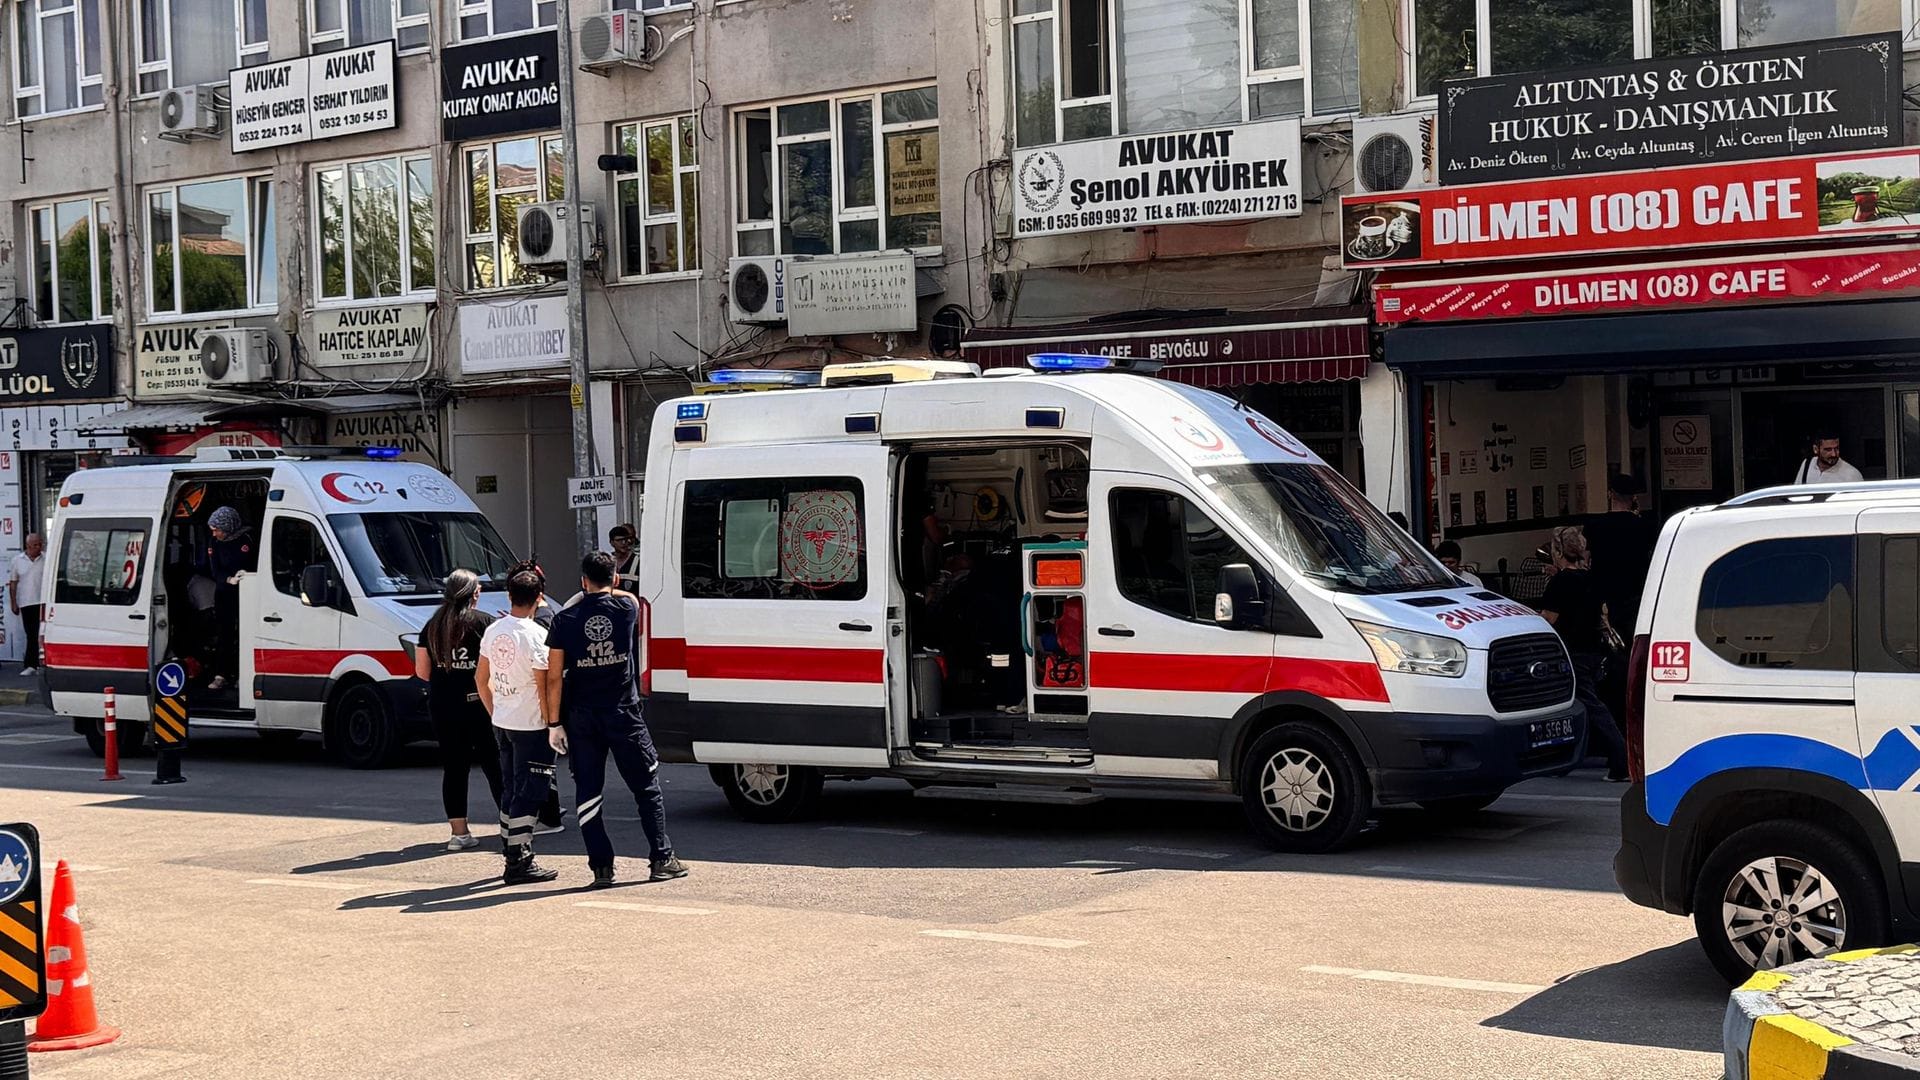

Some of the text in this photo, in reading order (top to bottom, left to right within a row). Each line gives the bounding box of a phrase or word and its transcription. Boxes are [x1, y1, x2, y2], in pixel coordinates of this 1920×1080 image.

[325, 50, 376, 80] AVUKAT
[461, 55, 539, 89] AVUKAT
[245, 66, 292, 93] AVUKAT
[1514, 56, 1807, 108] ALTUNTAŞ & ÖKTEN
[313, 84, 389, 112] SERHAT YILDIRIM
[443, 81, 558, 119] KUTAY ONAT AKDAĞ
[236, 101, 271, 125] HÜSEYİN
[319, 109, 388, 129] 0532 130 54 53
[1489, 110, 1593, 144] HUKUK
[1617, 89, 1838, 131] DANIŞMANLIK
[239, 124, 302, 142] 0532 224 73 24
[1716, 133, 1738, 149] Av.
[1741, 129, 1783, 146] Ceren
[1827, 122, 1889, 142] Altuntaş
[1118, 130, 1234, 168] AVUKAT
[1447, 149, 1548, 173] Av. Deniz Ökten
[1570, 138, 1695, 161] Av. Ceyda Altuntaş
[1070, 159, 1289, 210] Şenol AKYÜREK
[1018, 193, 1297, 233] GSM: 0 535 689 99 32 TEL & FAX: (0224) 271 27 13
[1432, 177, 1804, 246] DİLMEN (08) CAFE
[775, 259, 784, 313] BEKO
[1882, 265, 1918, 285] Sucuklu
[1535, 268, 1786, 308] DİLMEN (08) CAFE
[338, 308, 402, 327] AVUKAT
[487, 304, 538, 329] AVUKAT
[368, 327, 421, 349] KAPLAN
[1149, 339, 1209, 359] BEYOĞLU
[167, 368, 181, 376] 251
[335, 414, 436, 436] AVUKATLAR
[353, 481, 389, 495] 112
[580, 479, 605, 490] ADLİYE
[572, 490, 612, 506] ÇIKIŞ YÖNÜ
[587, 641, 615, 657] 112
[1657, 646, 1685, 665] 112
[577, 657, 596, 667] ACİL
